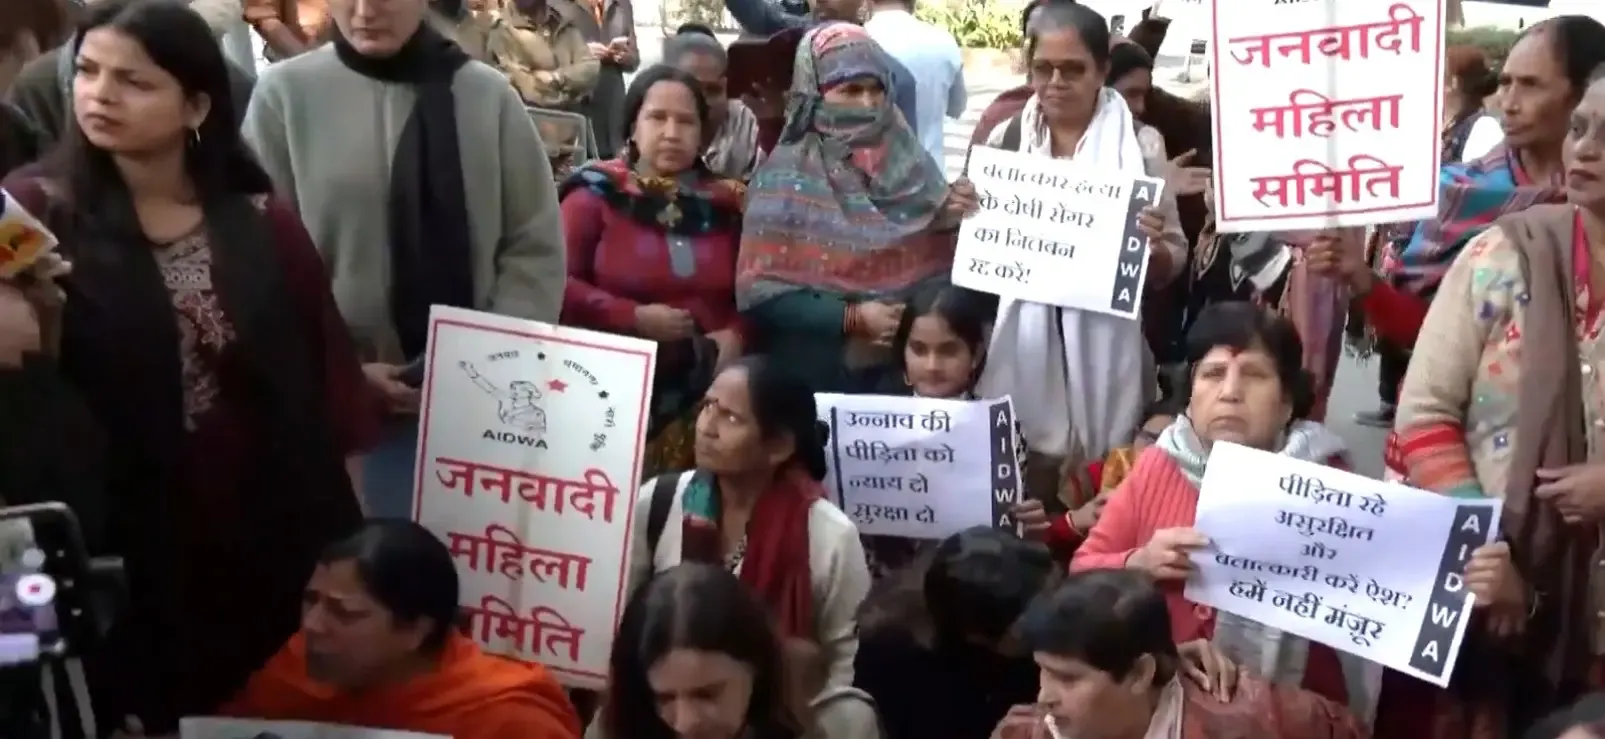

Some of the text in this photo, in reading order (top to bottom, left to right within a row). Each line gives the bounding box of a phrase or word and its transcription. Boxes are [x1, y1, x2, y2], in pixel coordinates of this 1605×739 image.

[1229, 3, 1425, 69] जनवादी
[1249, 88, 1404, 138] महिला
[1249, 154, 1404, 208] समिति
[980, 188, 998, 210] के
[1003, 194, 1043, 219] दोषी
[974, 227, 1000, 244] का
[1117, 185, 1149, 302] ADWA
[483, 429, 549, 449] AIDWA
[844, 409, 952, 433] उन्नाव की
[845, 441, 956, 467] पीड़िता को
[994, 410, 1015, 527] AIDWA
[436, 457, 621, 523] जनवादी
[849, 472, 929, 494] न्याय दो
[1278, 474, 1389, 515] पीड़िता रहे
[852, 502, 908, 525] सुरक्षा
[1274, 508, 1375, 542] असुरक्षित
[447, 524, 593, 592] महिला
[1301, 541, 1339, 561] और
[1215, 551, 1414, 610] बलात्कारी करें ऐश?
[1228, 579, 1269, 602] हमें
[1272, 587, 1323, 618] नहीं
[1420, 513, 1482, 663] AIDWA
